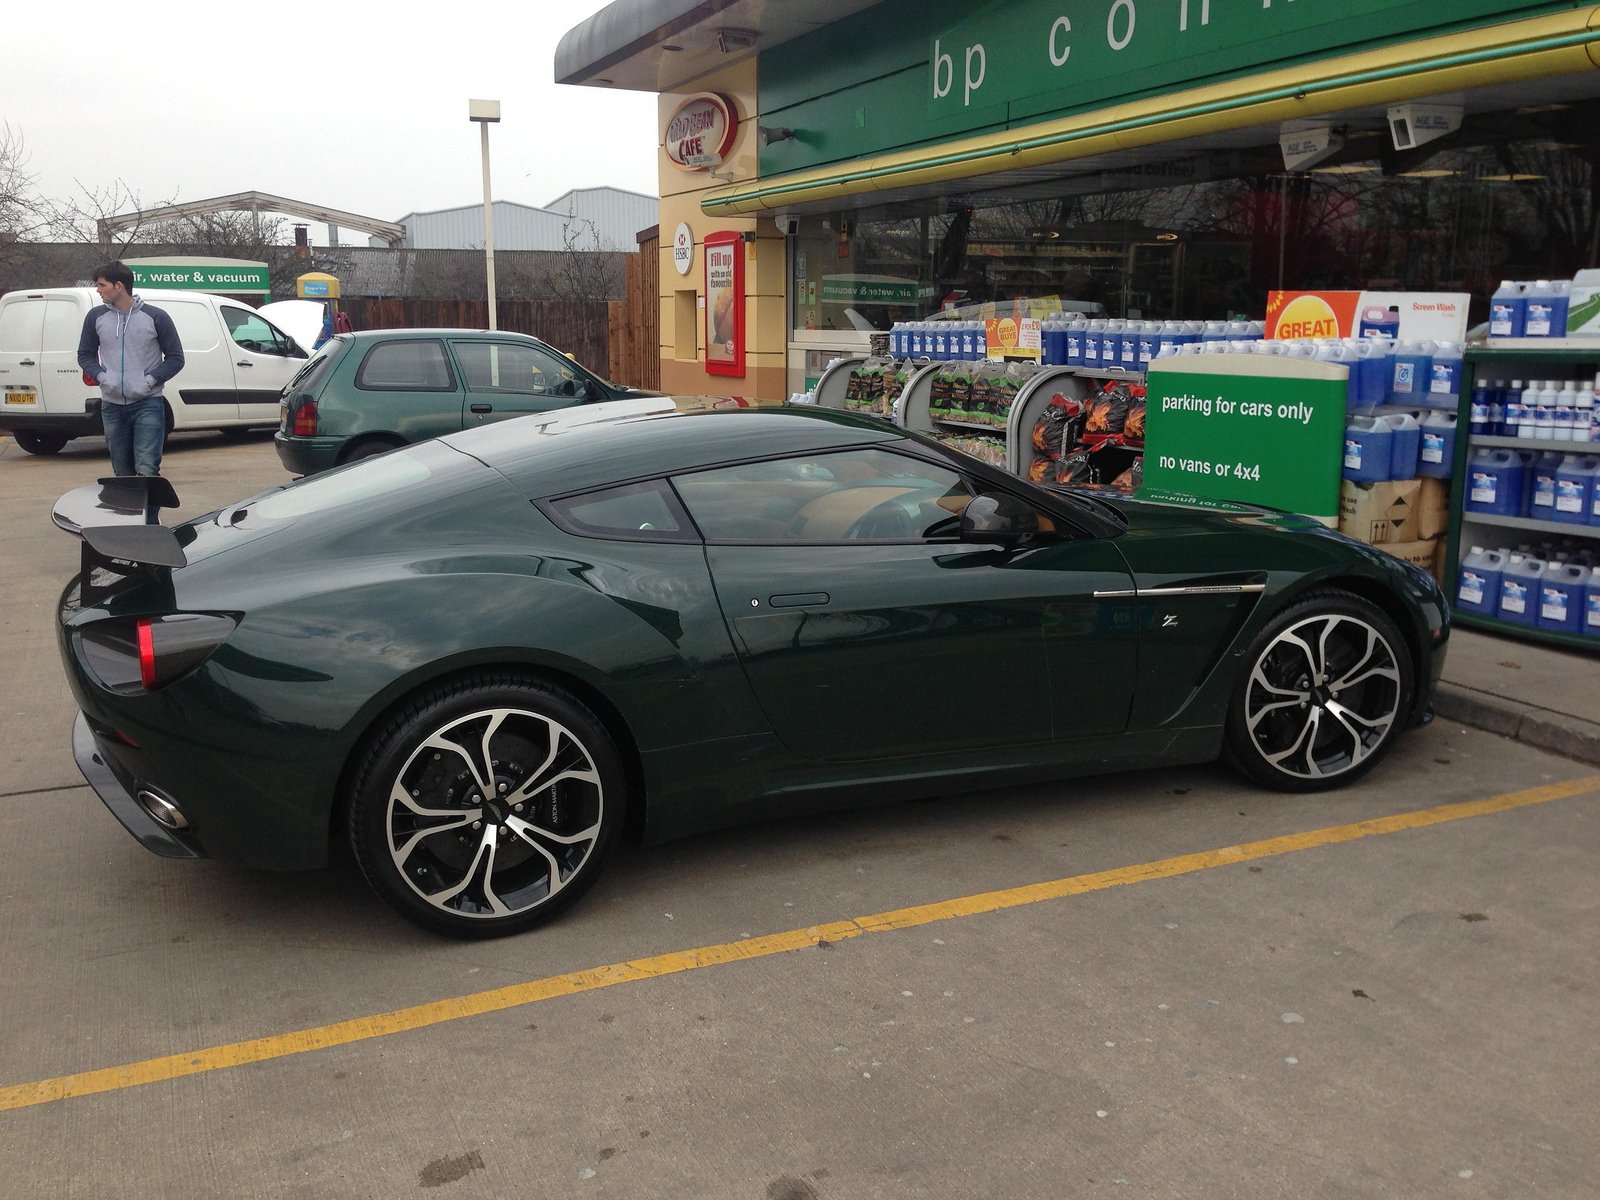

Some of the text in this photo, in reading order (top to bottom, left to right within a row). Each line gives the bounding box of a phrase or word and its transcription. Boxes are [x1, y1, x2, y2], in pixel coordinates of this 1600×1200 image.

[933, 39, 986, 107] bp
[675, 247, 690, 260] HSBC
[710, 252, 732, 270] Fill up
[133, 271, 260, 283] ir, water & vacuum
[710, 279, 733, 289] favourite
[1412, 302, 1456, 312] Screen Wash
[999, 326, 1016, 334] GREAT
[1000, 332, 1017, 340] BUYS
[1279, 319, 1335, 340] GREAT
[1162, 394, 1314, 424] parking for cars only
[1159, 455, 1261, 481] no vans or 4x4
